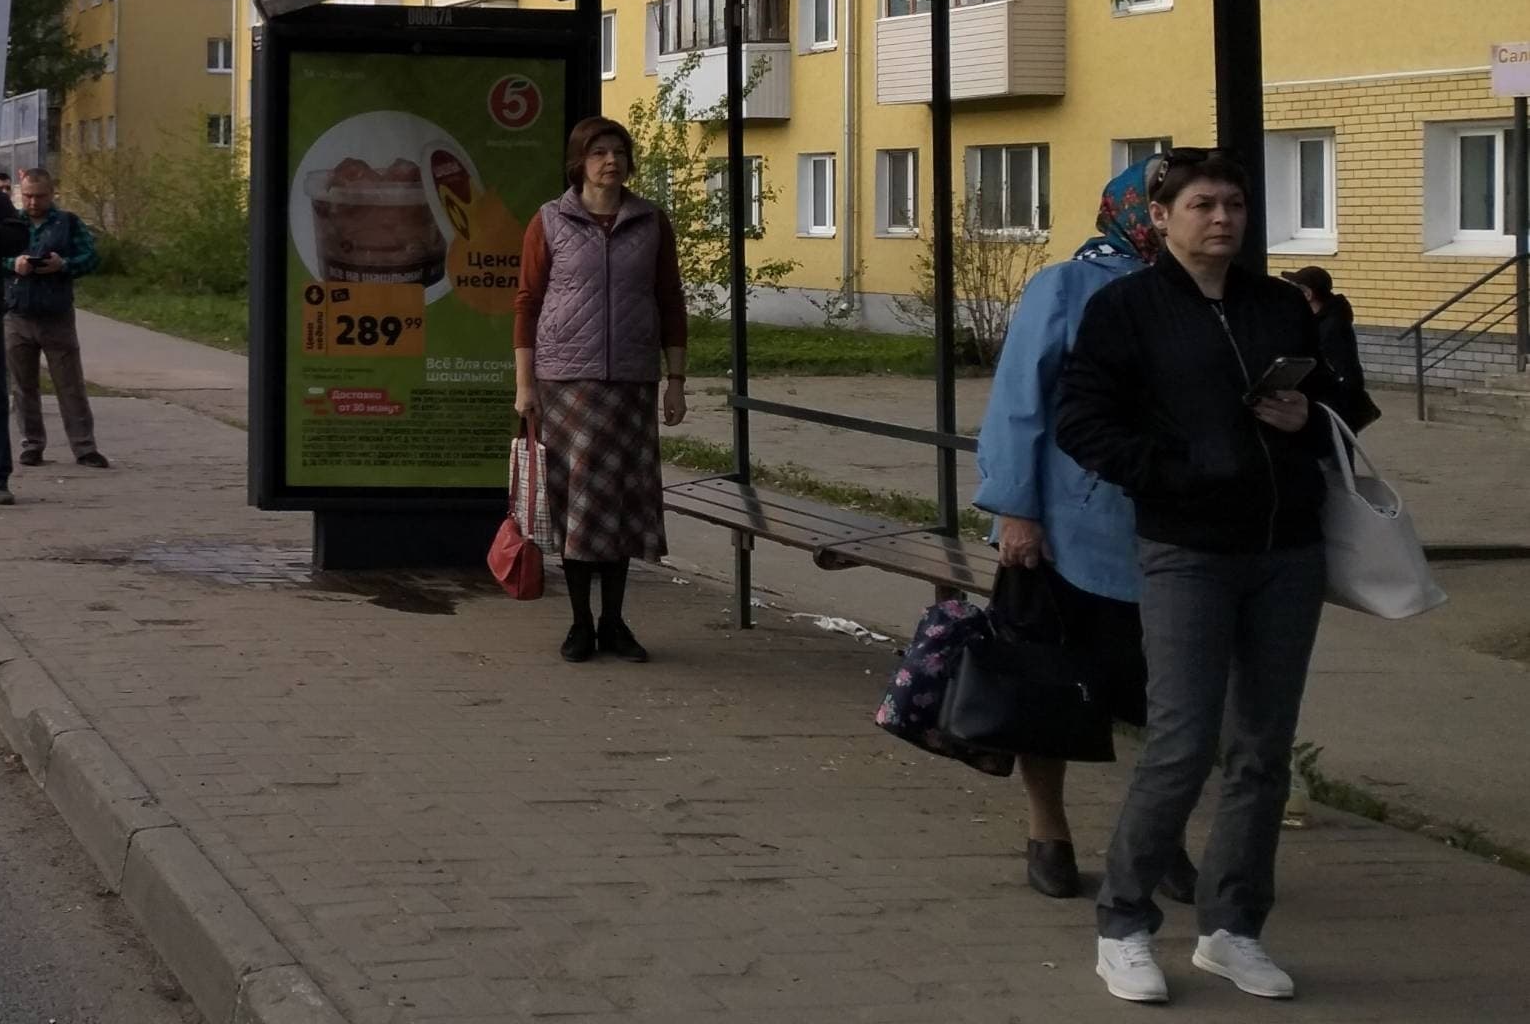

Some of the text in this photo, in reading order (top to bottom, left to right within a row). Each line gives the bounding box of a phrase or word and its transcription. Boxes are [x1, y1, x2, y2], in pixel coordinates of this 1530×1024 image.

[1498, 48, 1530, 63] Сал
[467, 251, 520, 269] Цена
[457, 275, 519, 288] недел
[336, 315, 423, 346] 289 99
[426, 357, 517, 370] Всё для сочн
[426, 372, 504, 383] шашлыка!
